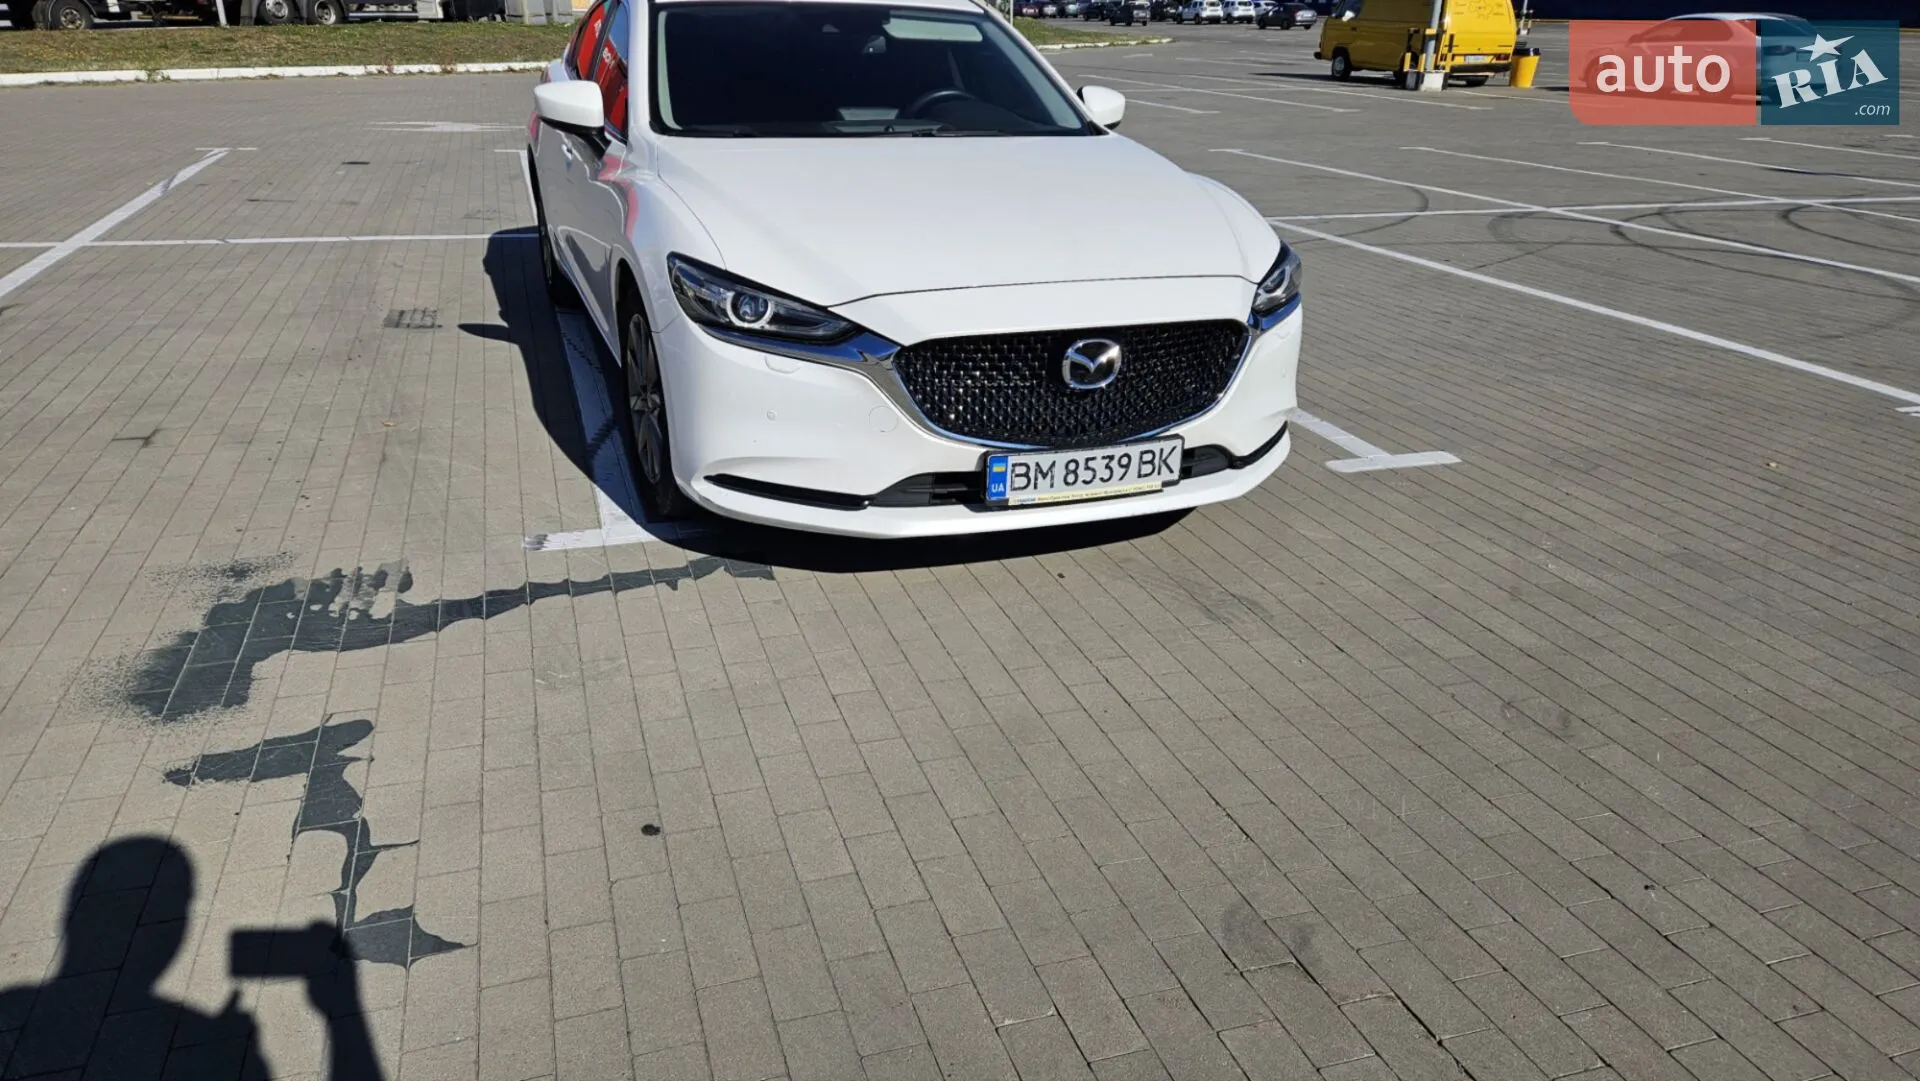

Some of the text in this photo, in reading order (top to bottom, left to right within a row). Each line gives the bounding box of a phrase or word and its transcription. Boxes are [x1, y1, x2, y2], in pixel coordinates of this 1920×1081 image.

[1011, 446, 1178, 491] BM 8539 BK
[991, 483, 1005, 493] UA
